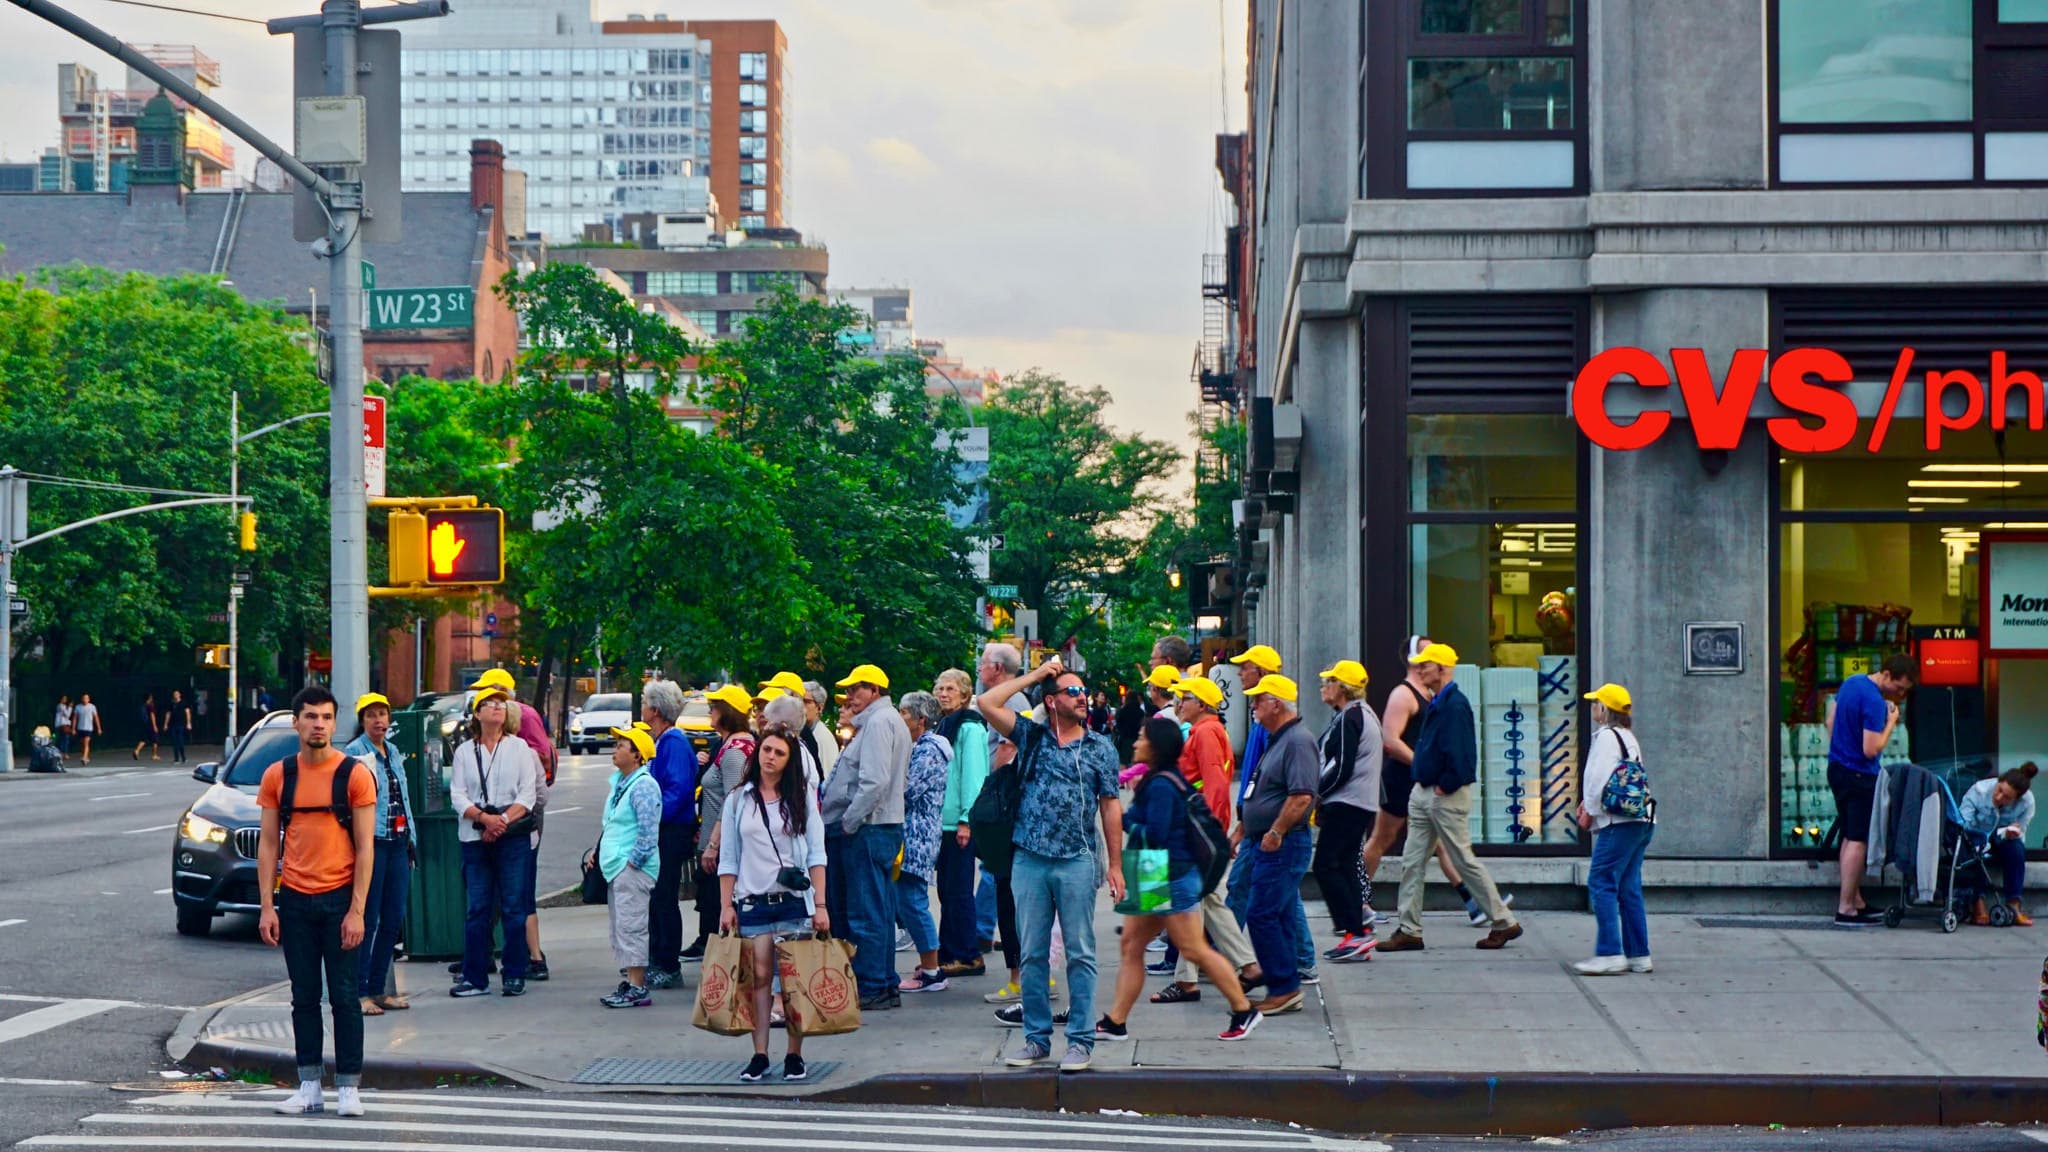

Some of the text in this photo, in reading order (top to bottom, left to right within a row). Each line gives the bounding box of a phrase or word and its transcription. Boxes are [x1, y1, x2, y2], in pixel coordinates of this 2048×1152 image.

[376, 292, 465, 324] W 23 St
[990, 587, 999, 598] W
[1933, 628, 1966, 639] ATM
